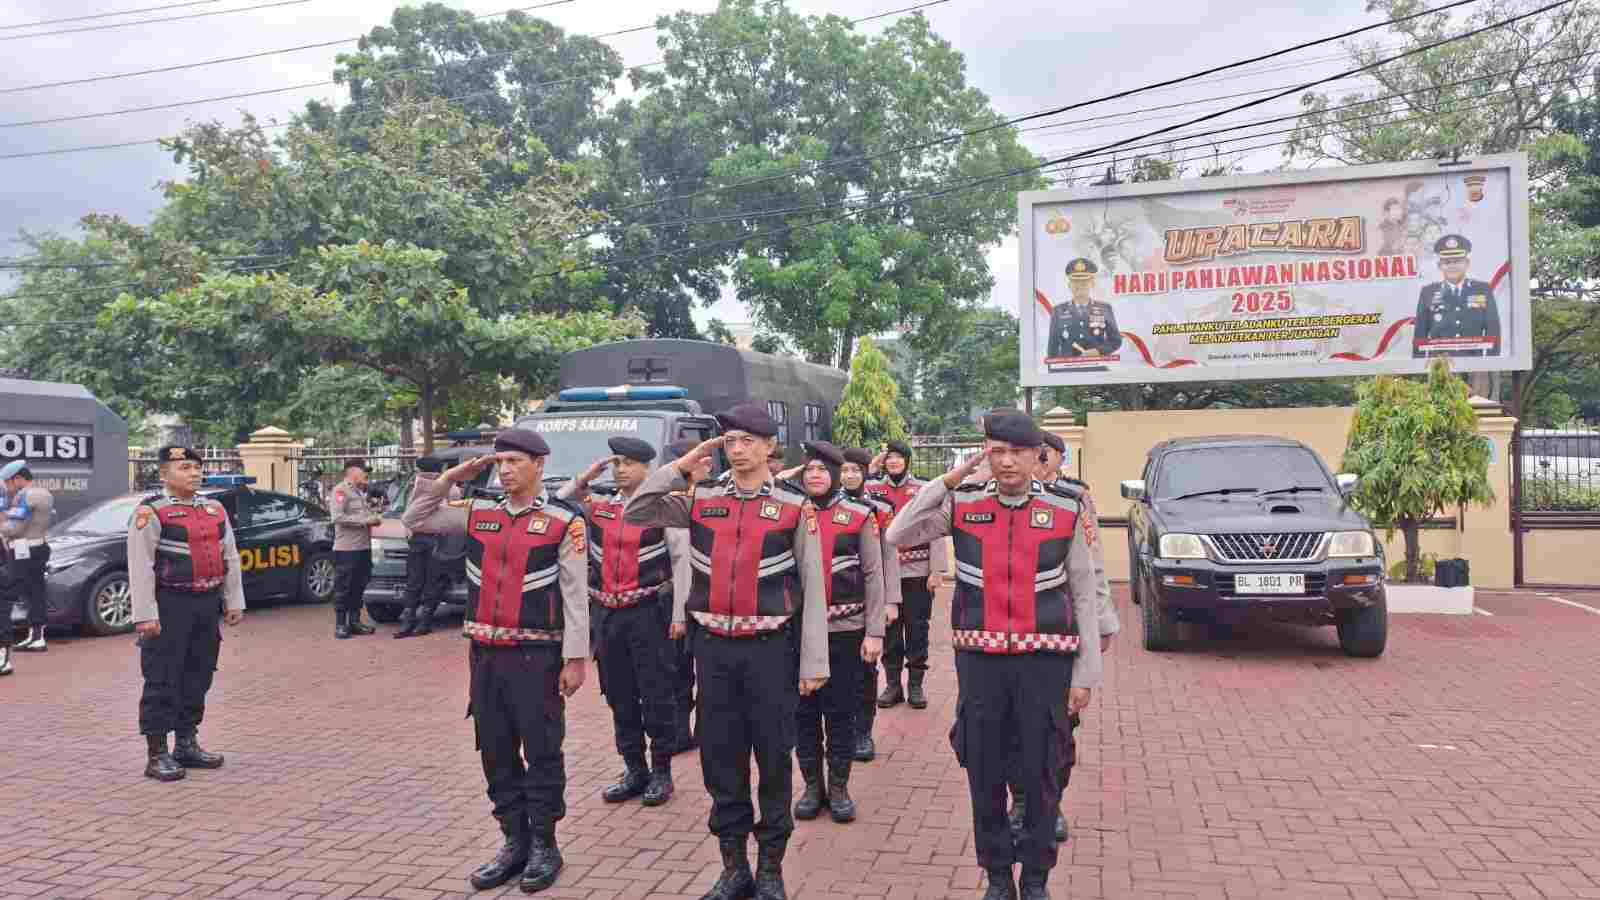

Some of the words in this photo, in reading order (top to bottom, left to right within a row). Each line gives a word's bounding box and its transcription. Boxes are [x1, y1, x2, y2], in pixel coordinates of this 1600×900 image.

[1165, 217, 1362, 262] UPACARA
[1114, 272, 1166, 294] HARI
[1172, 263, 1294, 290] PAHLAWAN
[1301, 255, 1417, 282] NASIONAL
[1231, 290, 1292, 313] 2025
[1152, 321, 1221, 335] PAHLAWANKU
[1222, 317, 1284, 331] TELADANKU
[1285, 316, 1321, 328] TERUS
[1322, 313, 1380, 326] BERGERAK
[1266, 327, 1339, 341] PERJUANGAN
[535, 418, 577, 433] KORPS
[579, 416, 638, 433] SABHARA
[0, 434, 87, 458] OLISI
[64, 478, 89, 491] ACEH
[239, 545, 300, 571] OLISI
[1237, 575, 1250, 587] BL
